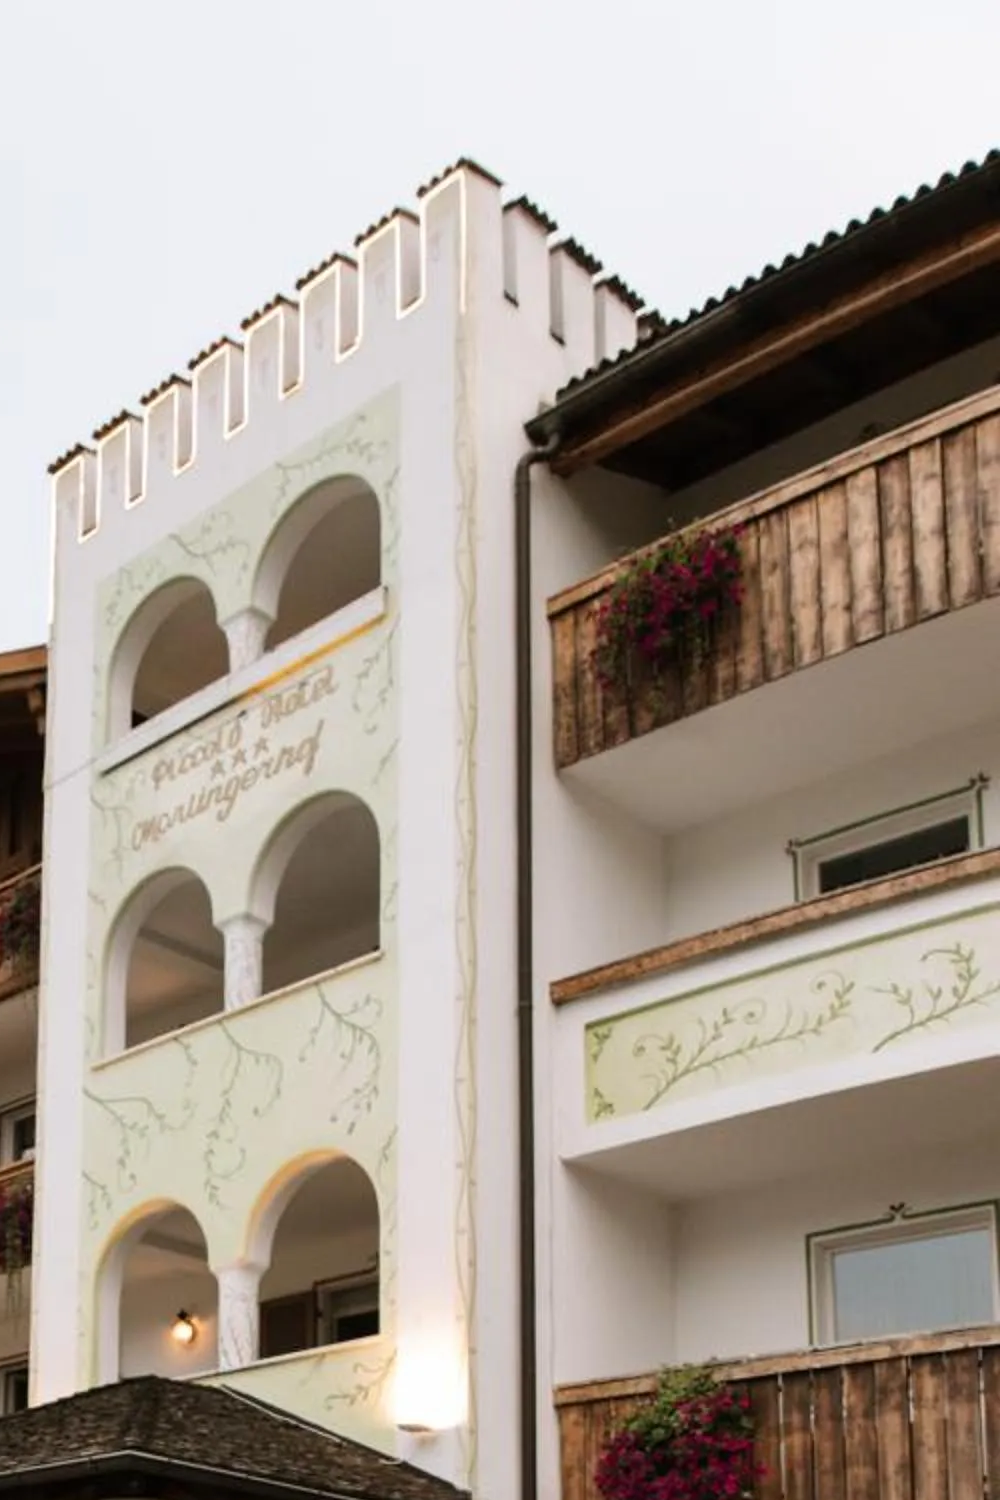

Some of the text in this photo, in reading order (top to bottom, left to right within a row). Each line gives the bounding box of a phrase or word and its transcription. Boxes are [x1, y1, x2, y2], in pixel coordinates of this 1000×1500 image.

[131, 718, 325, 852] Marlingerhof
[151, 665, 340, 791] Piccolo Hotel
